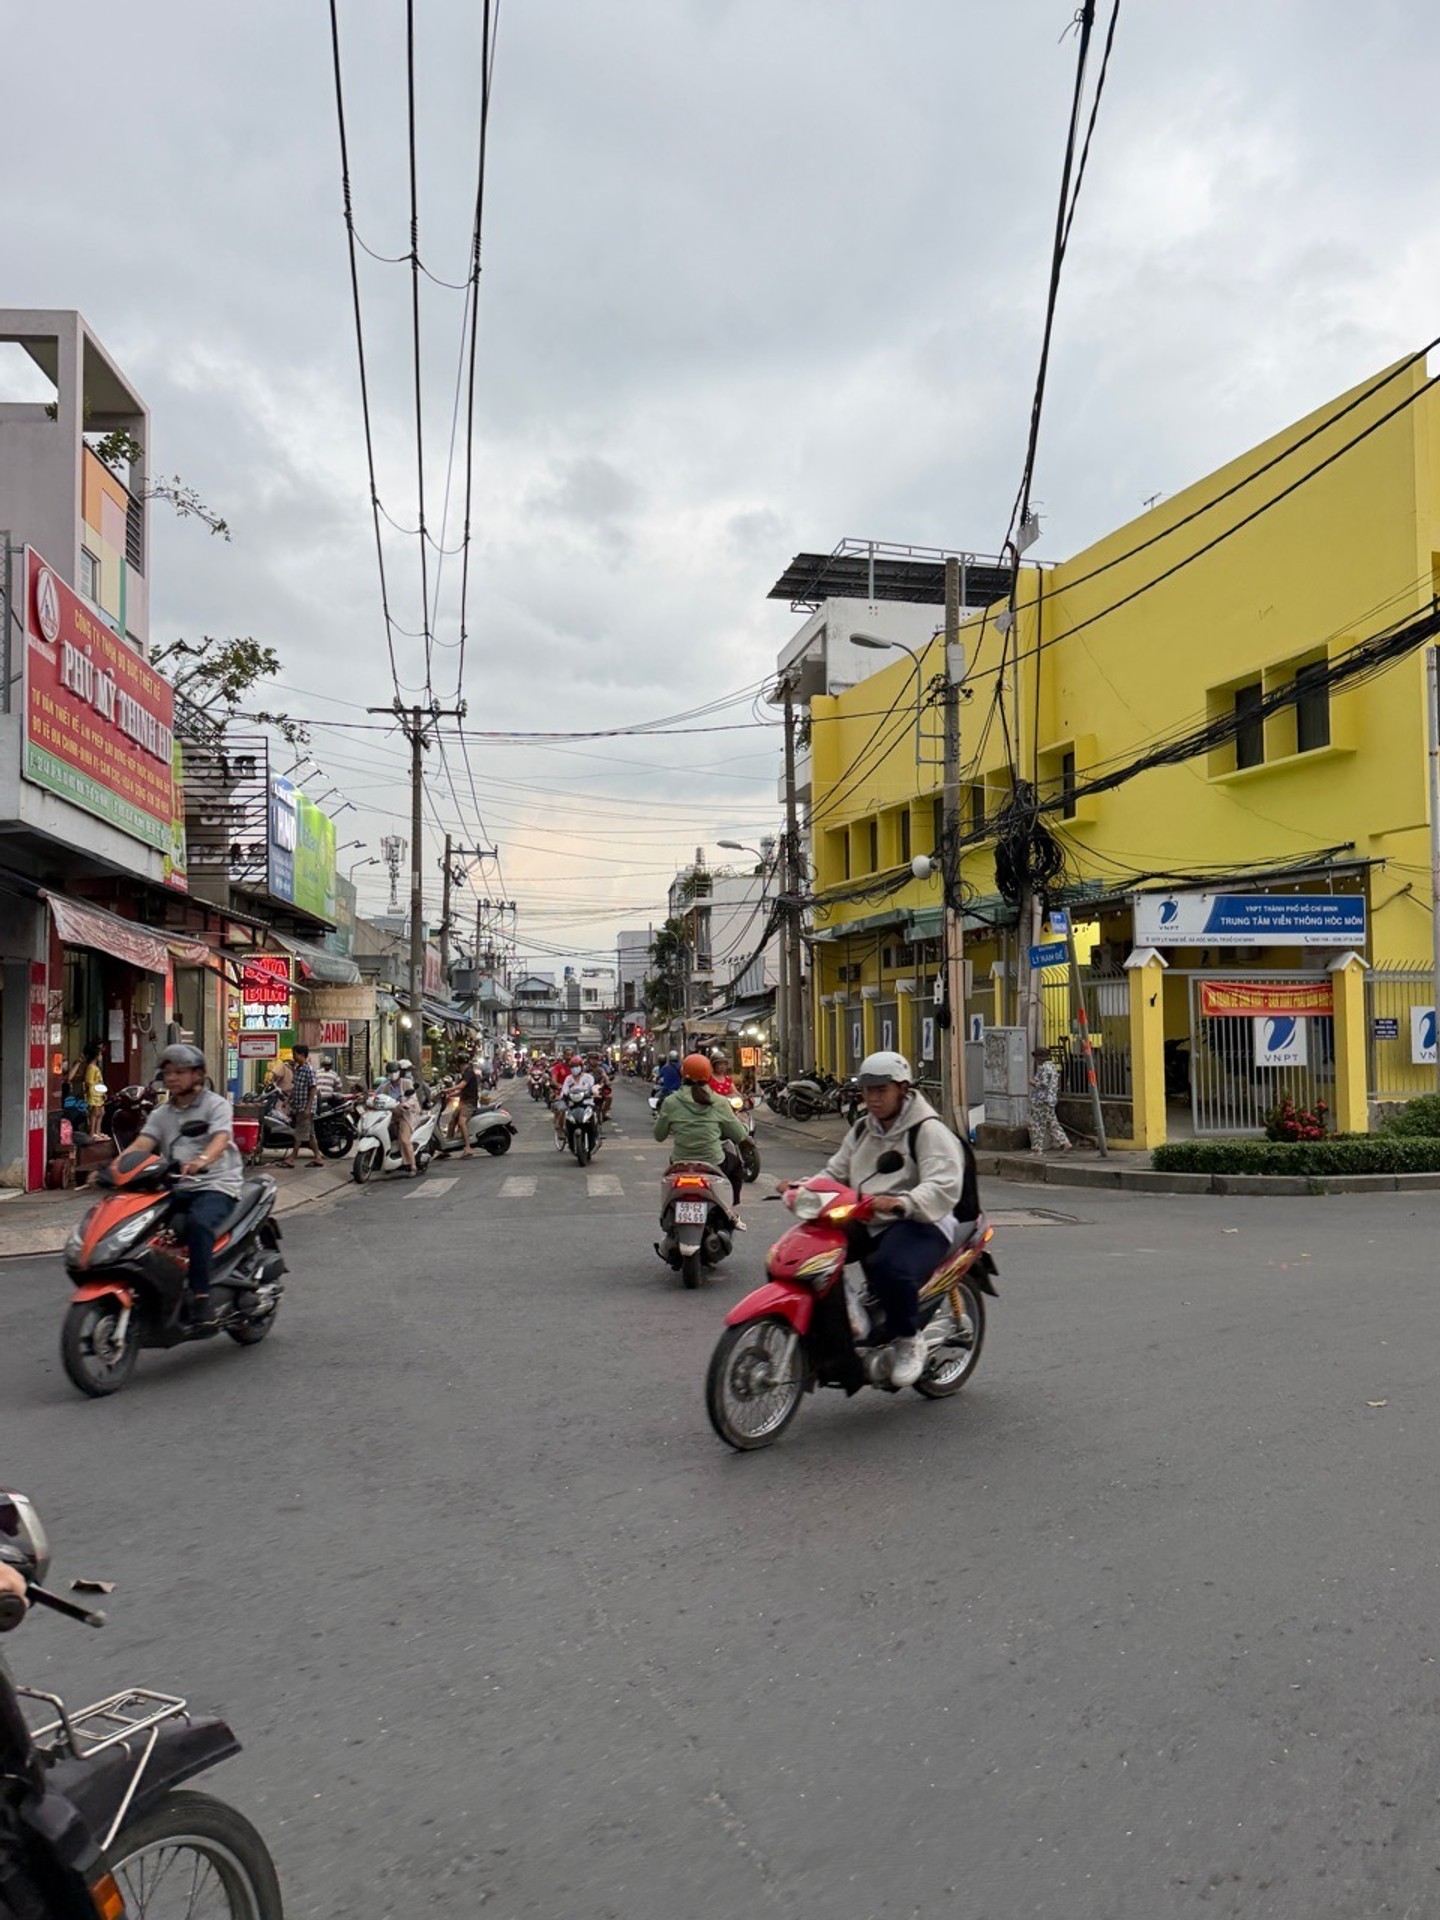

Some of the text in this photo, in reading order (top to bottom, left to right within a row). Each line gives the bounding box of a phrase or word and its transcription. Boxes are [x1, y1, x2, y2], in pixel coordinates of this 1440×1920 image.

[1220, 916, 1251, 926] TRUNG
[1252, 915, 1271, 926] TÂM
[1271, 913, 1292, 926] VIỄN
[1293, 915, 1323, 926] THÔNG
[1344, 915, 1363, 926] MÔN
[1420, 1051, 1436, 1059] VN
